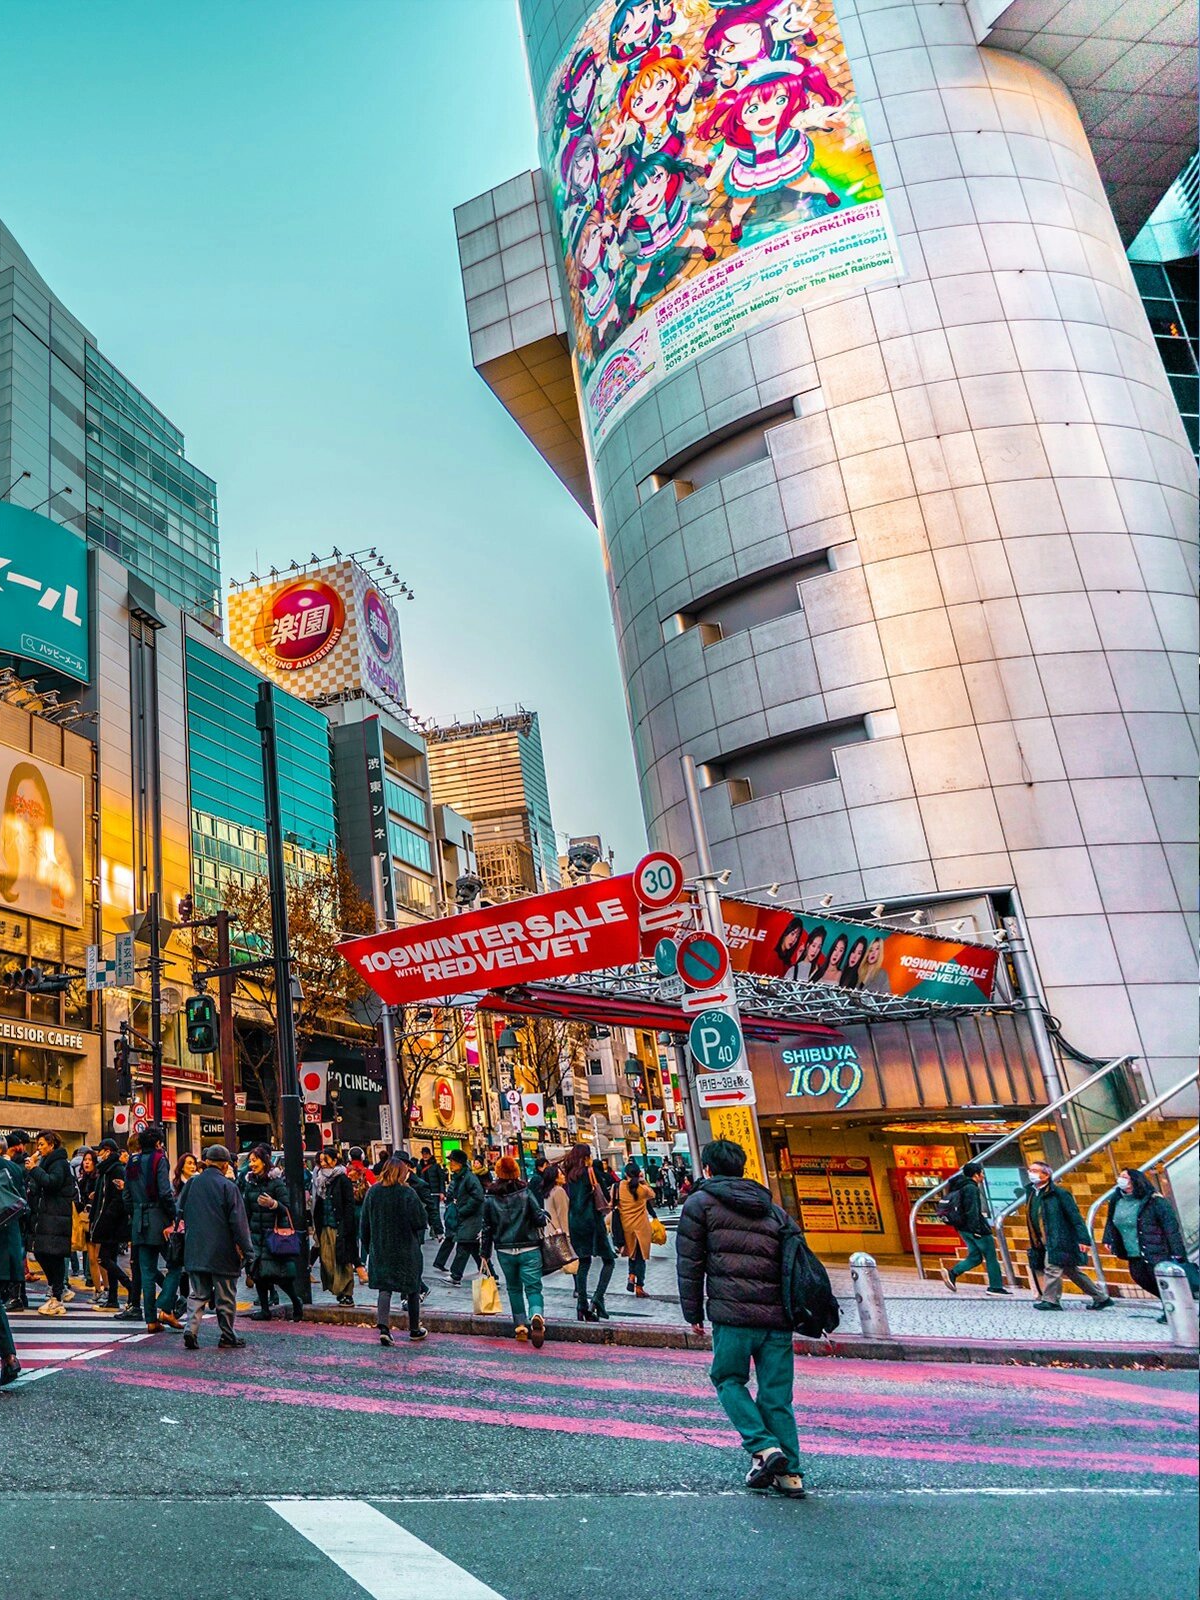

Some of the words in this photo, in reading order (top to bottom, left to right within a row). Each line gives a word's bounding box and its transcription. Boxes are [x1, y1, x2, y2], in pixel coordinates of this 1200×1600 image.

[765, 240, 790, 255] Next
[760, 264, 788, 281] Hop?
[792, 251, 826, 269] Stop?
[691, 277, 729, 303] Release!
[786, 284, 807, 296] Over
[810, 277, 826, 287] The
[828, 270, 849, 280] Next
[697, 299, 735, 324] Release!
[698, 324, 736, 350] Release!
[269, 603, 331, 648] 楽園
[40, 644, 83, 670] ハッピーメール
[258, 647, 293, 671] EXCITING
[295, 626, 342, 670] AMUSEMENT
[644, 865, 673, 894] 30
[688, 934, 706, 943] 20-7
[395, 966, 422, 979] WITH
[700, 1012, 724, 1025] 7-20
[47, 1028, 83, 1049] CAFFÉ
[700, 1027, 721, 1065] P
[718, 1046, 733, 1063] 40
[782, 1044, 858, 1064] SHIBUYA
[344, 1073, 383, 1093] CINEM
[785, 1061, 863, 1109] 109
[509, 1093, 516, 1102] 4
[203, 1124, 240, 1133] CINES
